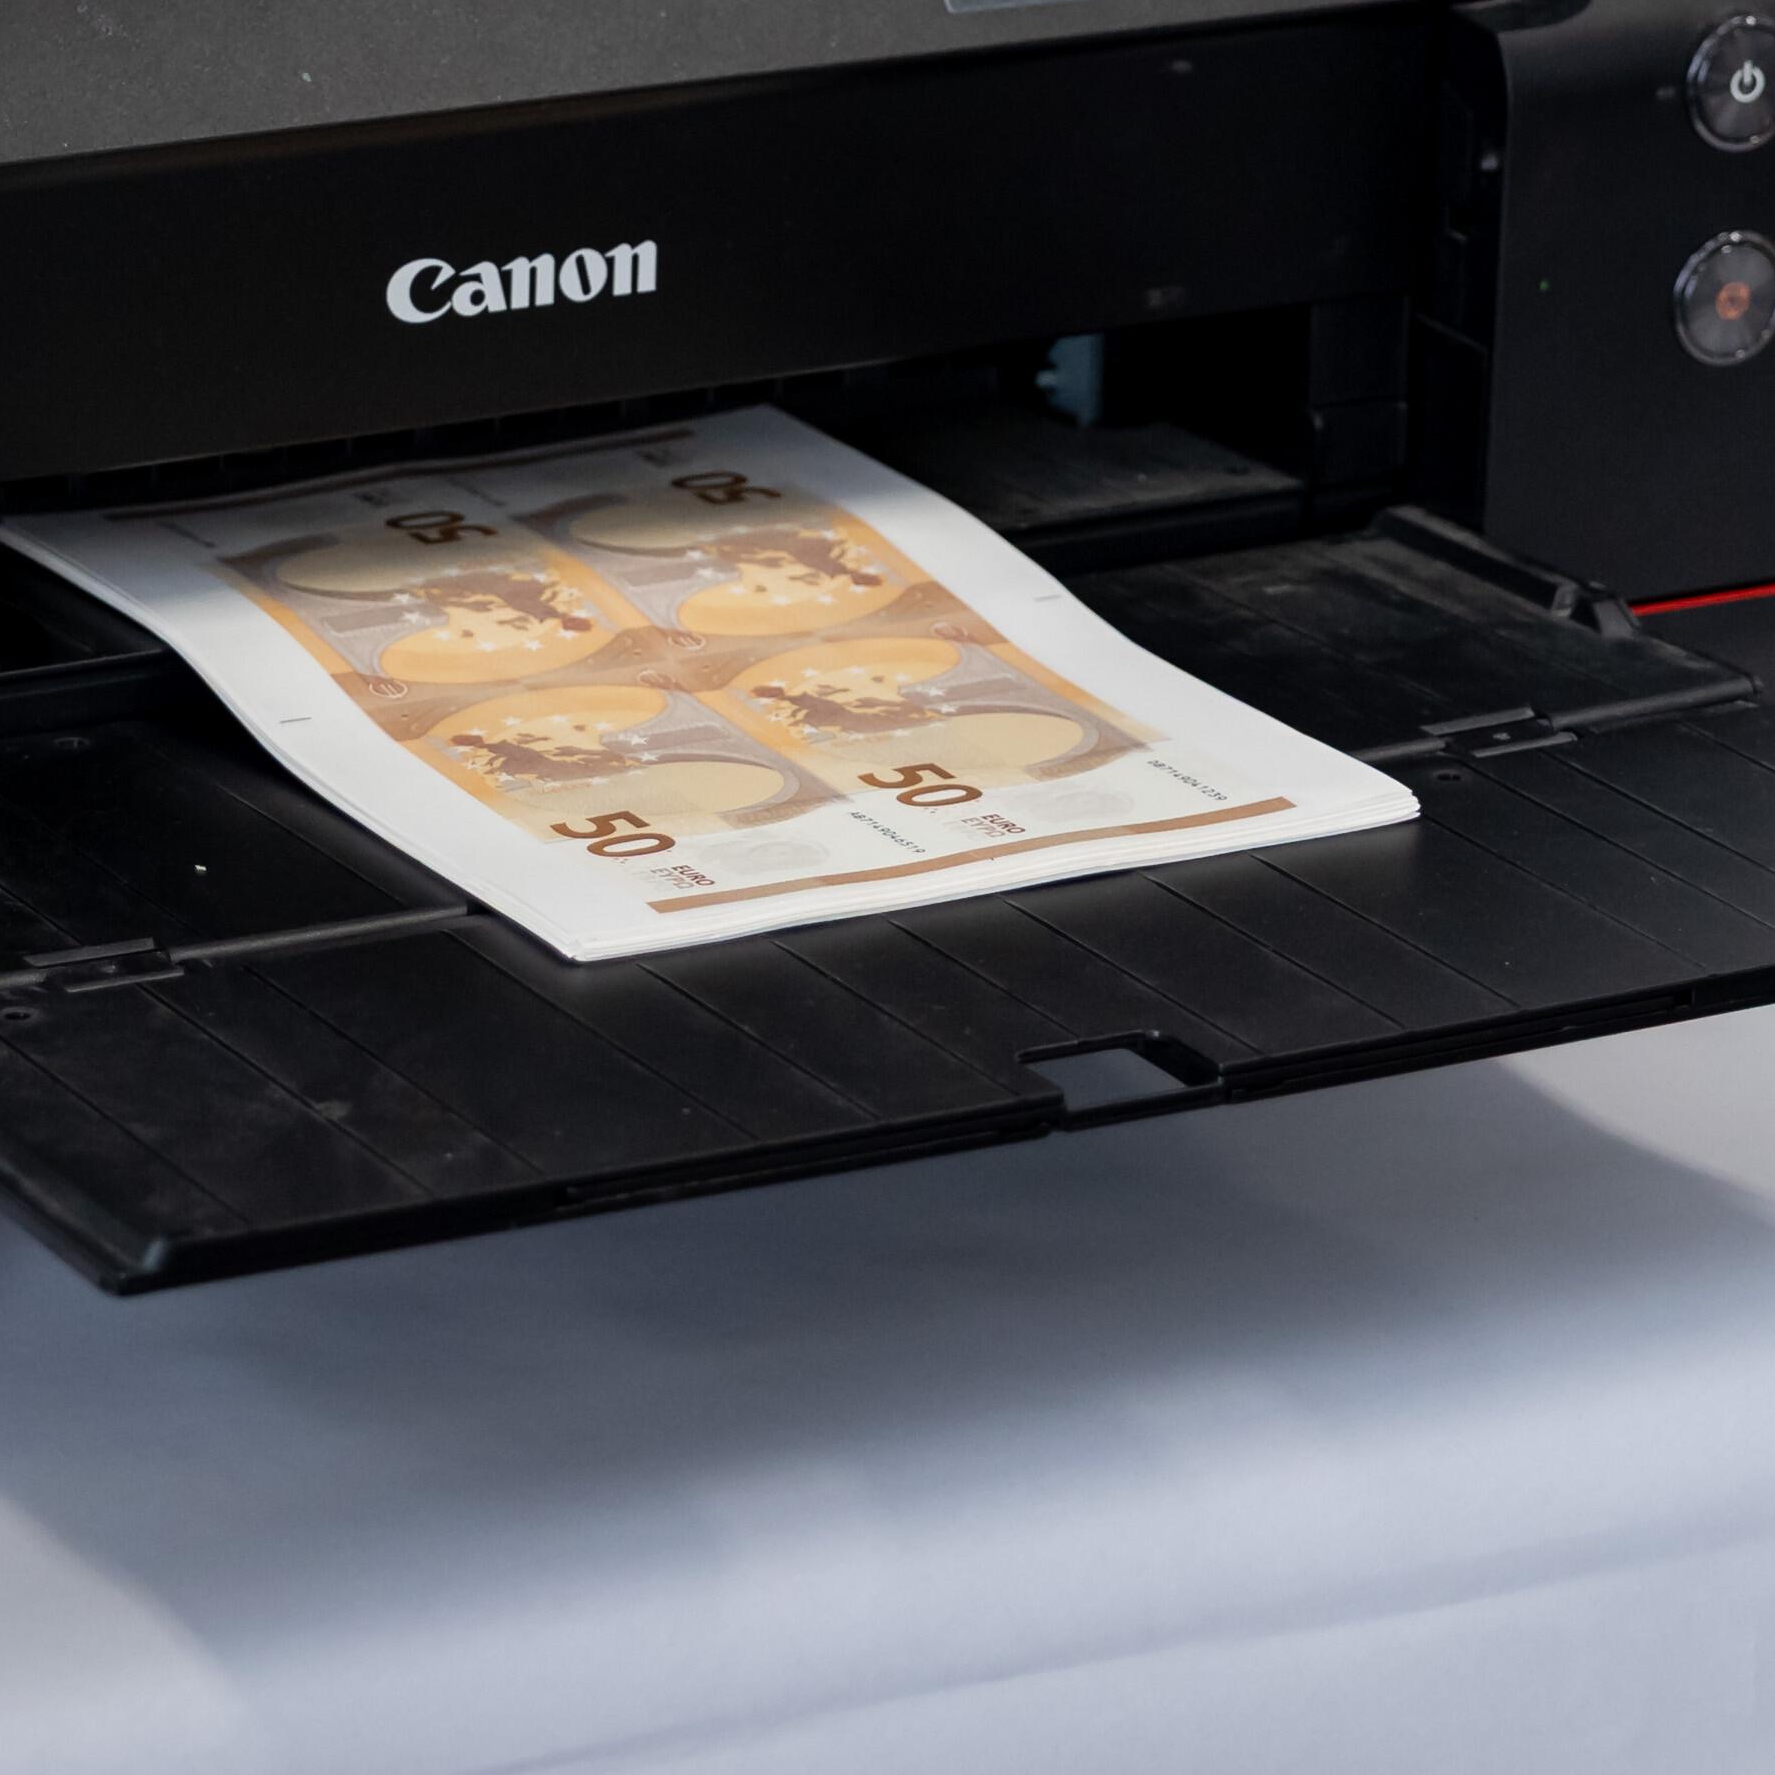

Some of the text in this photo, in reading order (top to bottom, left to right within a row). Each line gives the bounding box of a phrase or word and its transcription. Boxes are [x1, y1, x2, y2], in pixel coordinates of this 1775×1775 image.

[386, 239, 657, 323] Canon
[857, 763, 983, 807] 50
[549, 811, 676, 857] 50
[981, 813, 1026, 835] EURO
[671, 864, 716, 887] EURO
